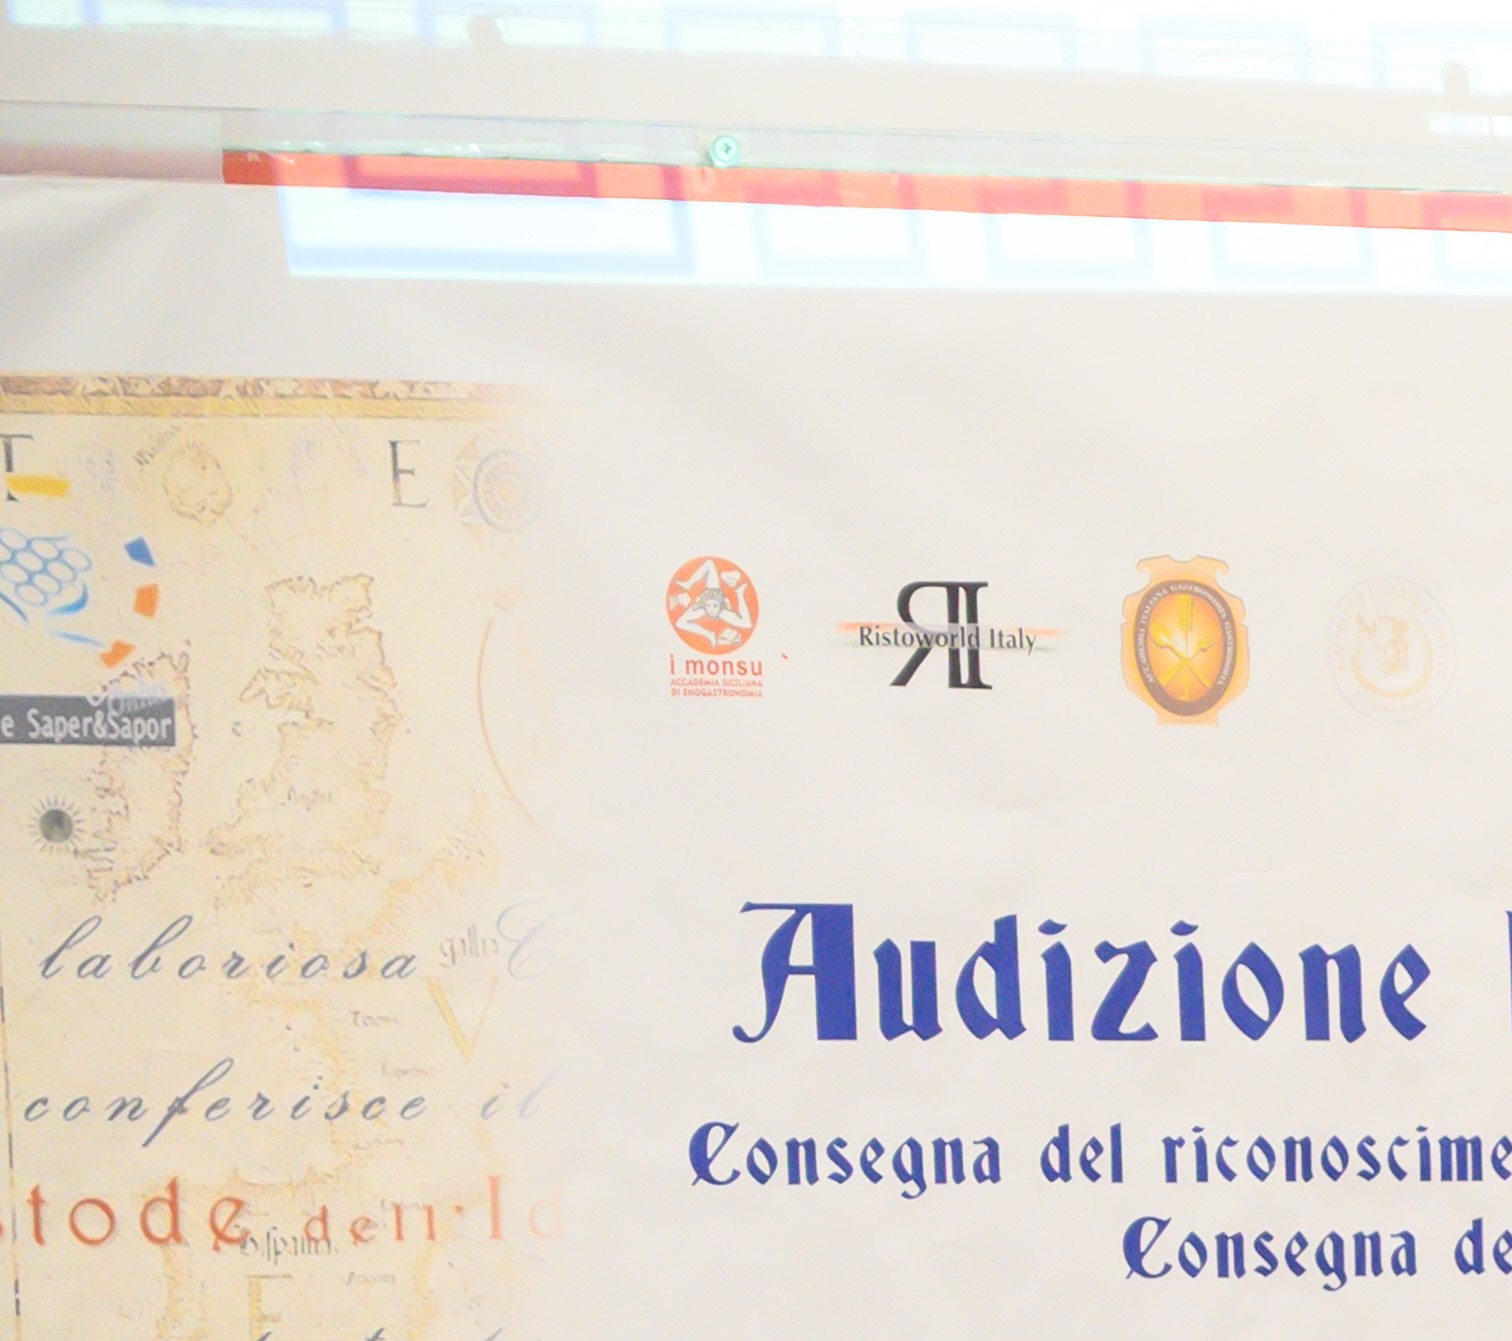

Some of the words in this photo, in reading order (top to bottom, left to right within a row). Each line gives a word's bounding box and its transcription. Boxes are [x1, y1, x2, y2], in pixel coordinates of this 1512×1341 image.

[859, 625, 980, 649] Ristoworld
[990, 627, 1036, 656] Italy
[39, 914, 418, 982] laboriosa
[732, 901, 1433, 1044] Audizione
[23, 1057, 431, 1149] conferisce
[687, 1121, 1003, 1200] Consegna
[1039, 1122, 1125, 1185] del
[0, 1175, 250, 1250] tode
[1121, 1215, 1419, 1293] Consegna
